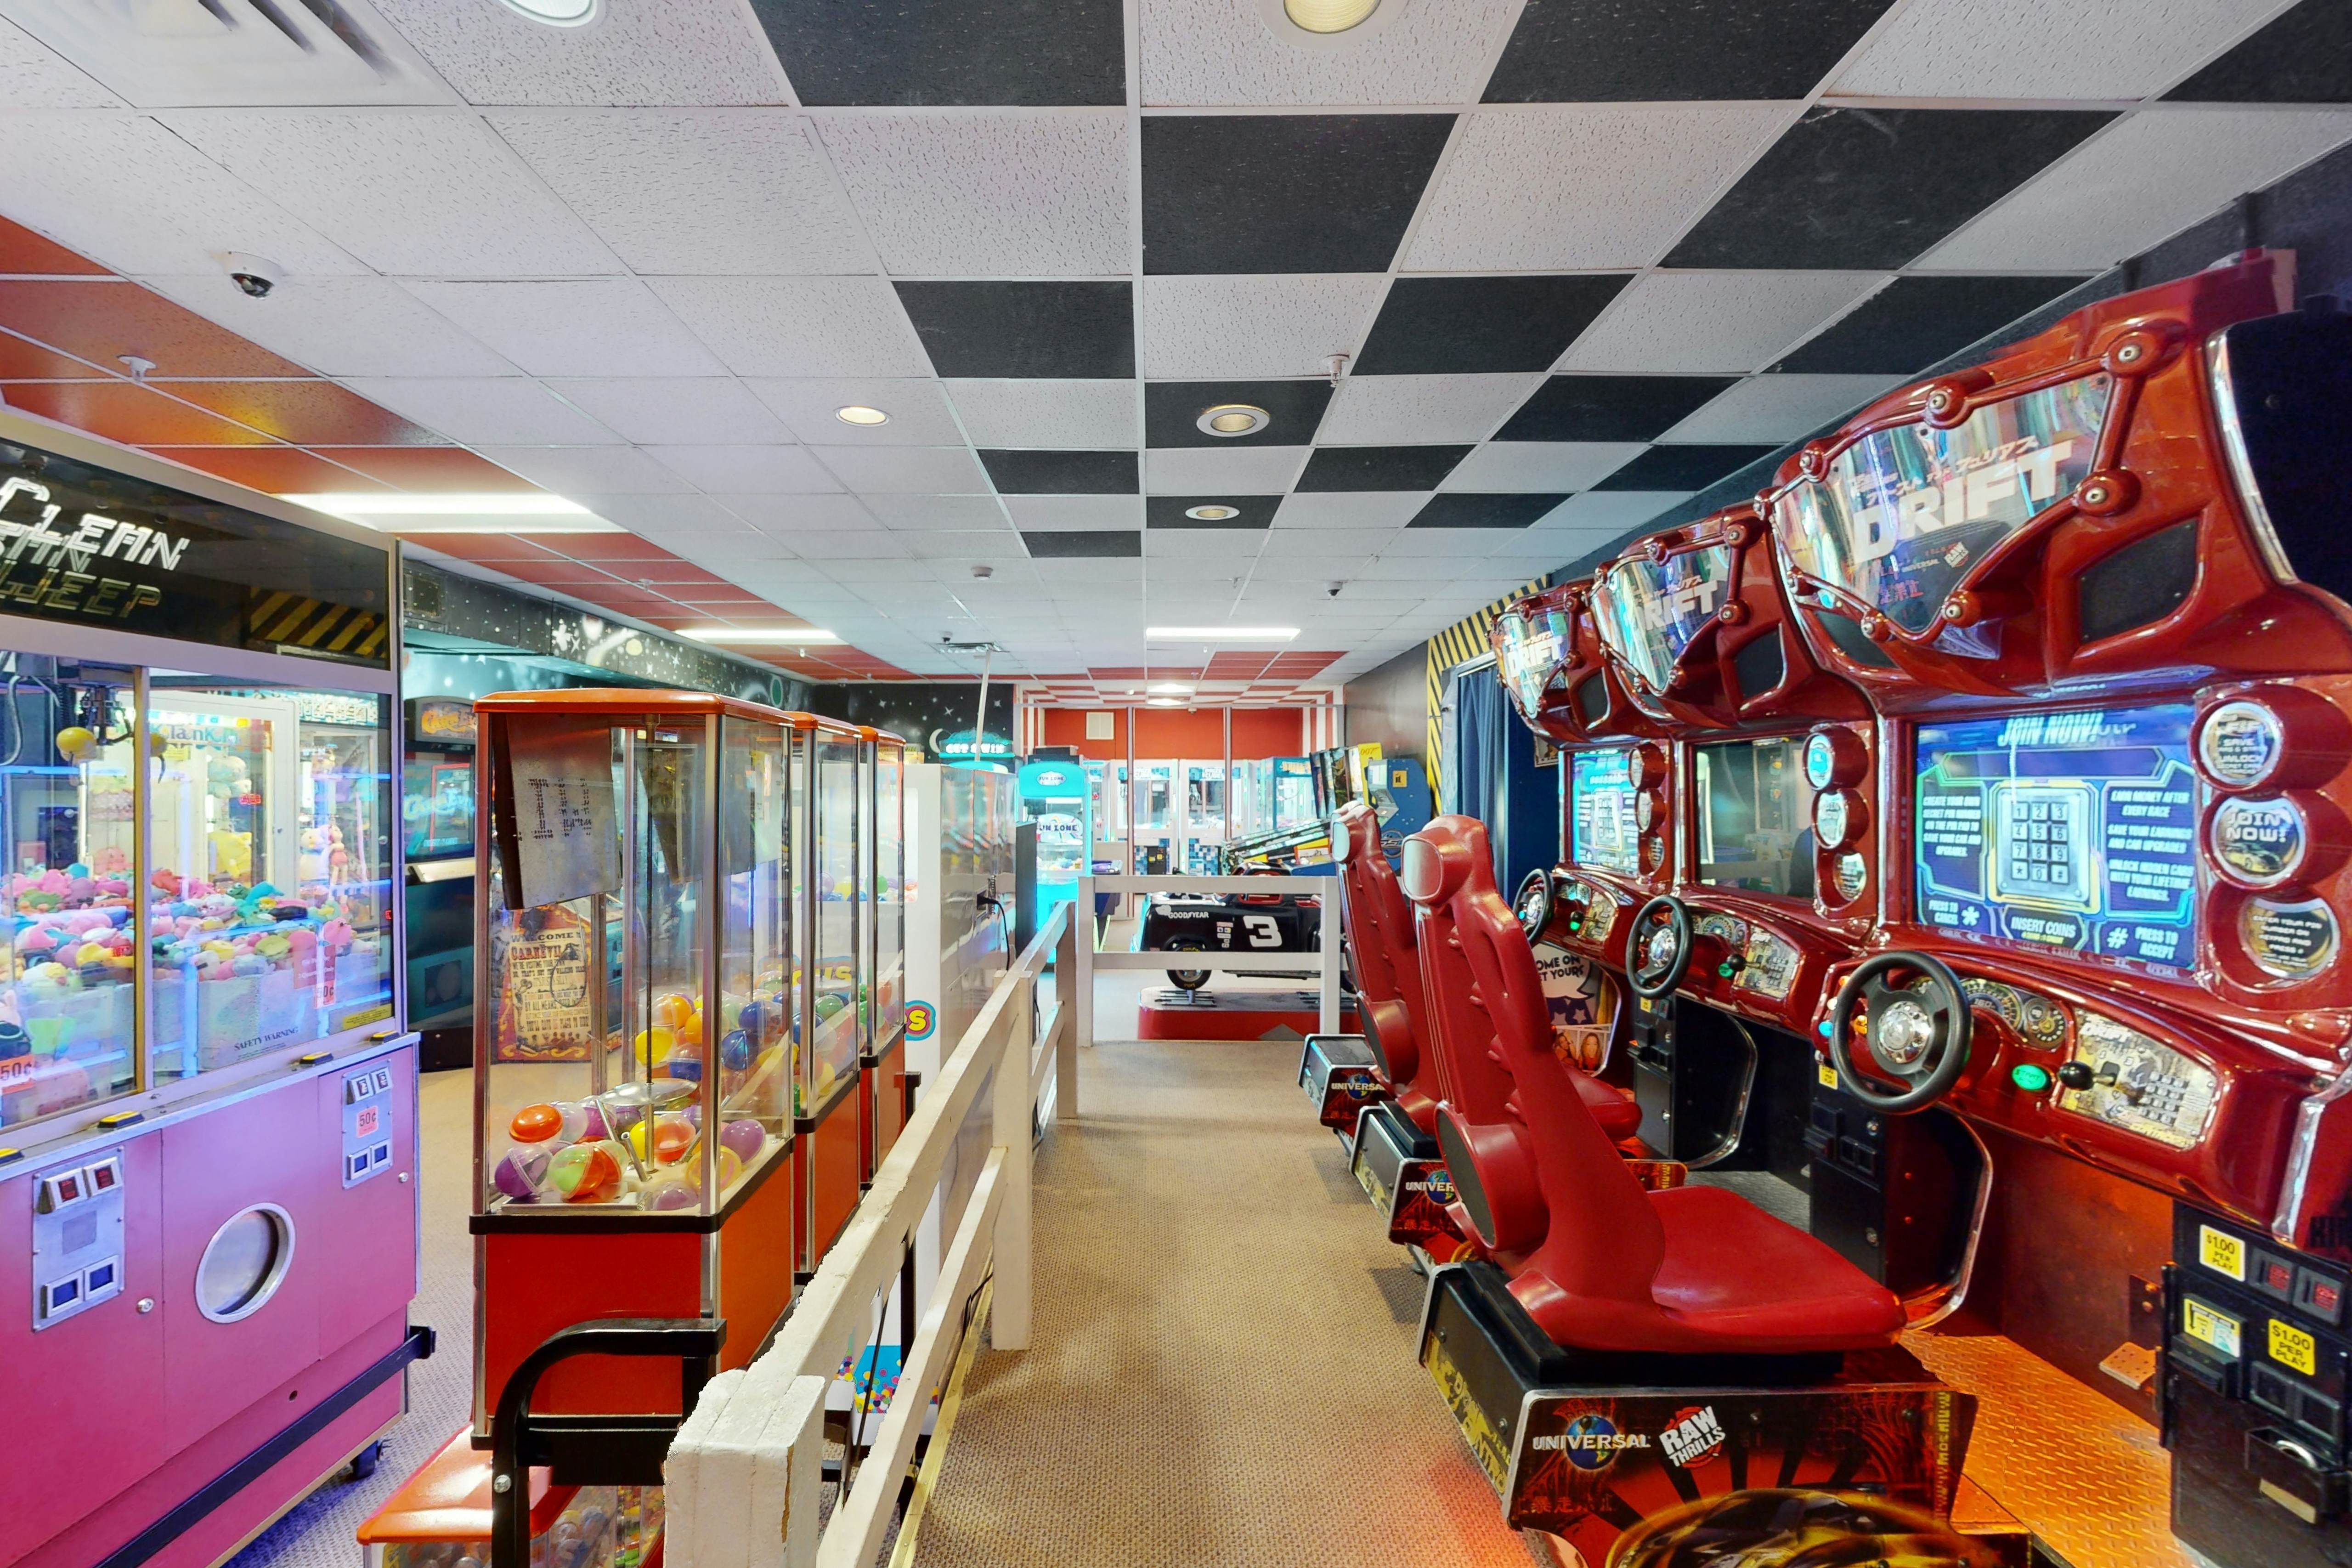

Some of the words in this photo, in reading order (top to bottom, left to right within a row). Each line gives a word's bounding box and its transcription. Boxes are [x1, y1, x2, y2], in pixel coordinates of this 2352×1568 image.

[1853, 440, 2073, 564] DRIFT
[0, 477, 190, 571] CLEAN
[0, 560, 161, 617] WEEP
[1507, 636, 1562, 678] DRIFT
[1998, 717, 2044, 747] JOIN
[2043, 713, 2104, 744] NOW!
[1360, 747, 1380, 756] 007
[2132, 791, 2163, 802] MONEY
[2162, 792, 2190, 804] AFTER
[2016, 808, 2021, 817] 1
[2036, 808, 2042, 818] 2
[2058, 808, 2063, 818] 3
[2121, 804, 2148, 816] EVERY
[2228, 812, 2280, 826] JOIN
[2036, 828, 2041, 838] 5
[2057, 830, 2063, 839] 6
[2107, 824, 2128, 835] SAVE
[2128, 825, 2150, 837] YOUR
[2226, 827, 2286, 842] NOW!
[2108, 838, 2126, 849] AND
[2125, 839, 2143, 850] CAR
[2016, 847, 2021, 857] 7
[2036, 848, 2041, 858] 8
[2058, 850, 2063, 860] 9
[1928, 900, 1949, 913] PRESS
[1949, 901, 1958, 913] TO
[1934, 911, 1958, 925] CANCEL
[1243, 915, 1283, 948] 3
[2011, 916, 2046, 935] INSERT
[2045, 920, 2076, 938] COINS
[511, 933, 574, 942] WCOME
[2135, 926, 2163, 942] PRESS
[2164, 931, 2179, 945] TO
[2139, 943, 2175, 959] ACCEPT
[1535, 957, 1560, 970] OME
[1563, 955, 1580, 965] ON
[1539, 972, 1548, 982] ET
[1551, 966, 1584, 979] YOURS
[234, 1036, 262, 1051] SAFETY
[264, 1027, 299, 1042] WARNING
[2079, 1022, 2132, 1042] DRIFT
[360, 1112, 376, 1126] 50¢
[1405, 1182, 1455, 1192] UNIVER
[2206, 1234, 2235, 1255] $1.00
[2212, 1258, 2234, 1271] PLAY
[2214, 1251, 2231, 1262] PER
[2272, 1325, 2311, 1351] $1.00
[2279, 1342, 2303, 1359] PER
[2276, 1349, 2307, 1369] PLAY
[1659, 1406, 1718, 1455] RAW
[1532, 1433, 1651, 1450] UNIVERSAL
[1668, 1426, 1726, 1467] THRILLS
